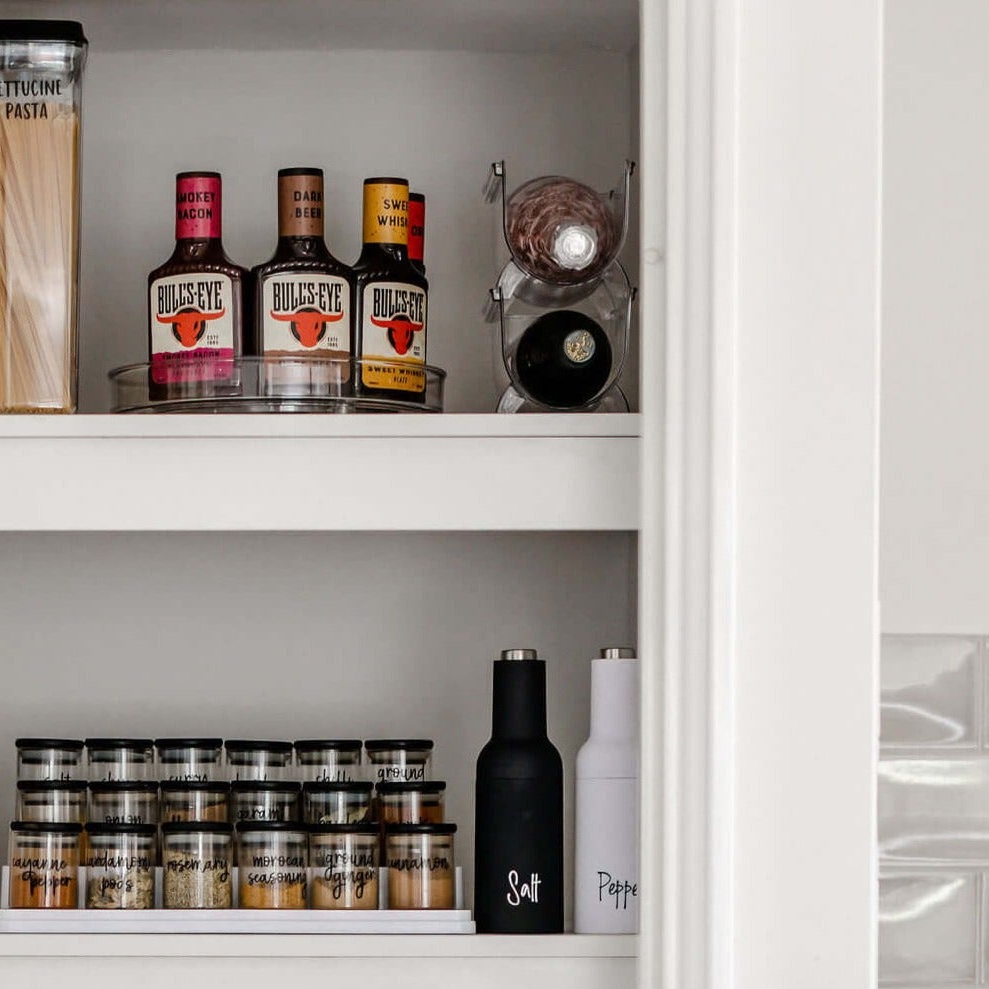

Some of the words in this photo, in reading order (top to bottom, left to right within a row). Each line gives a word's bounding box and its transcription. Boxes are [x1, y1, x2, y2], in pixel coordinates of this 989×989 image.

[5, 102, 48, 121] PASTA
[377, 763, 425, 782] ground
[506, 870, 542, 906] Salt
